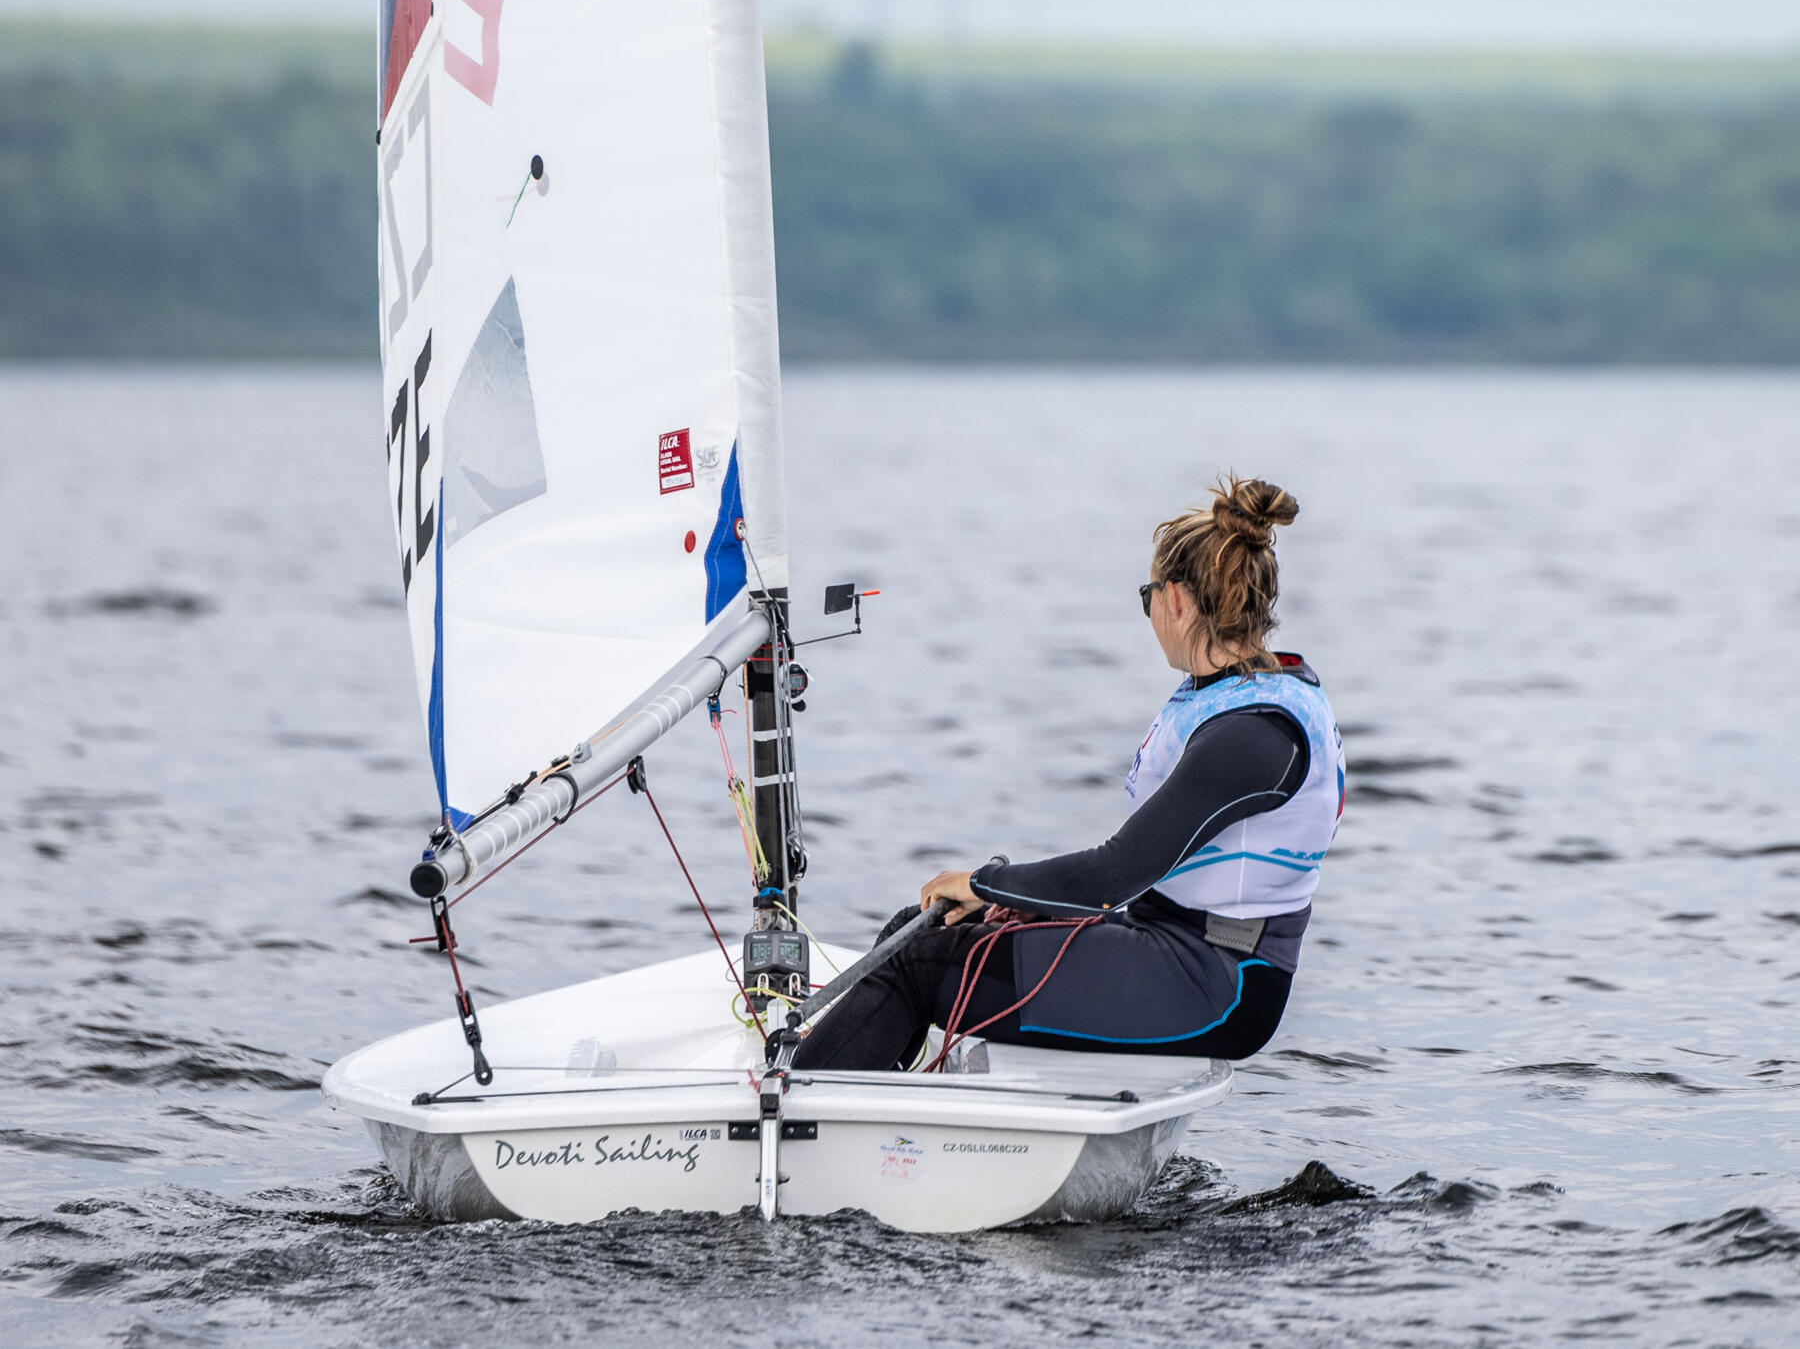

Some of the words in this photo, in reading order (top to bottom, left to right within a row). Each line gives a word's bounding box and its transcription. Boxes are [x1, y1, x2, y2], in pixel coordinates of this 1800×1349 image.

[685, 1129, 707, 1139] ILCA
[495, 1139, 585, 1170] Devoti
[594, 1134, 700, 1172] Sailing
